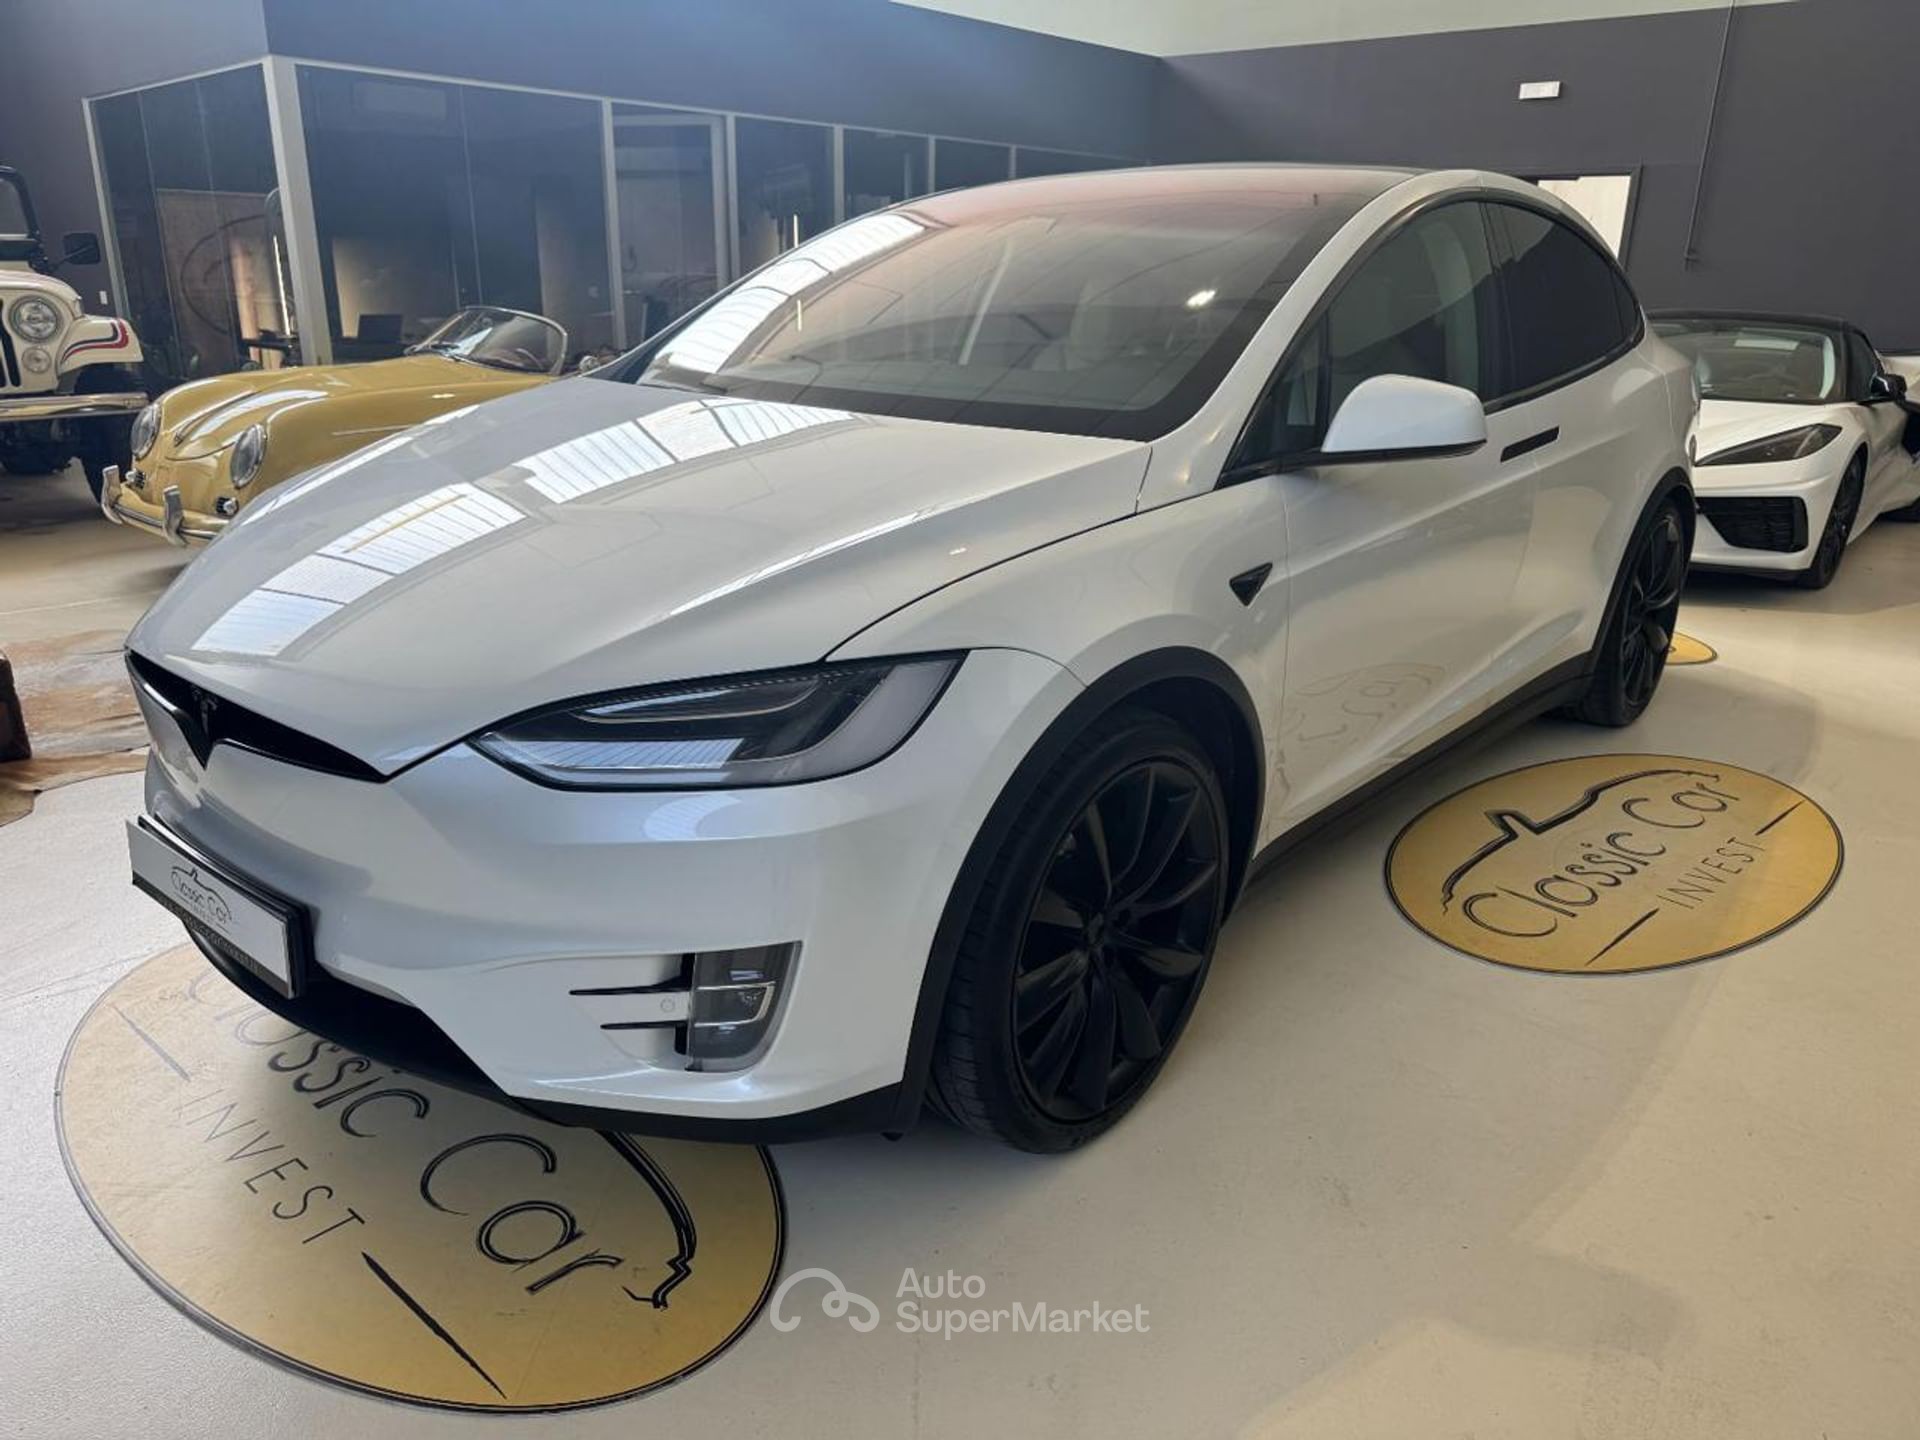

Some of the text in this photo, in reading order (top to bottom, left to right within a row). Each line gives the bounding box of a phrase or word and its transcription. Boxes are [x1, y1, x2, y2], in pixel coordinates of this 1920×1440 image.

[1463, 781, 1740, 937] Classic Car
[1656, 836, 1766, 909] INVEST
[172, 1089, 366, 1245] INVEST
[420, 1133, 623, 1294] Car
